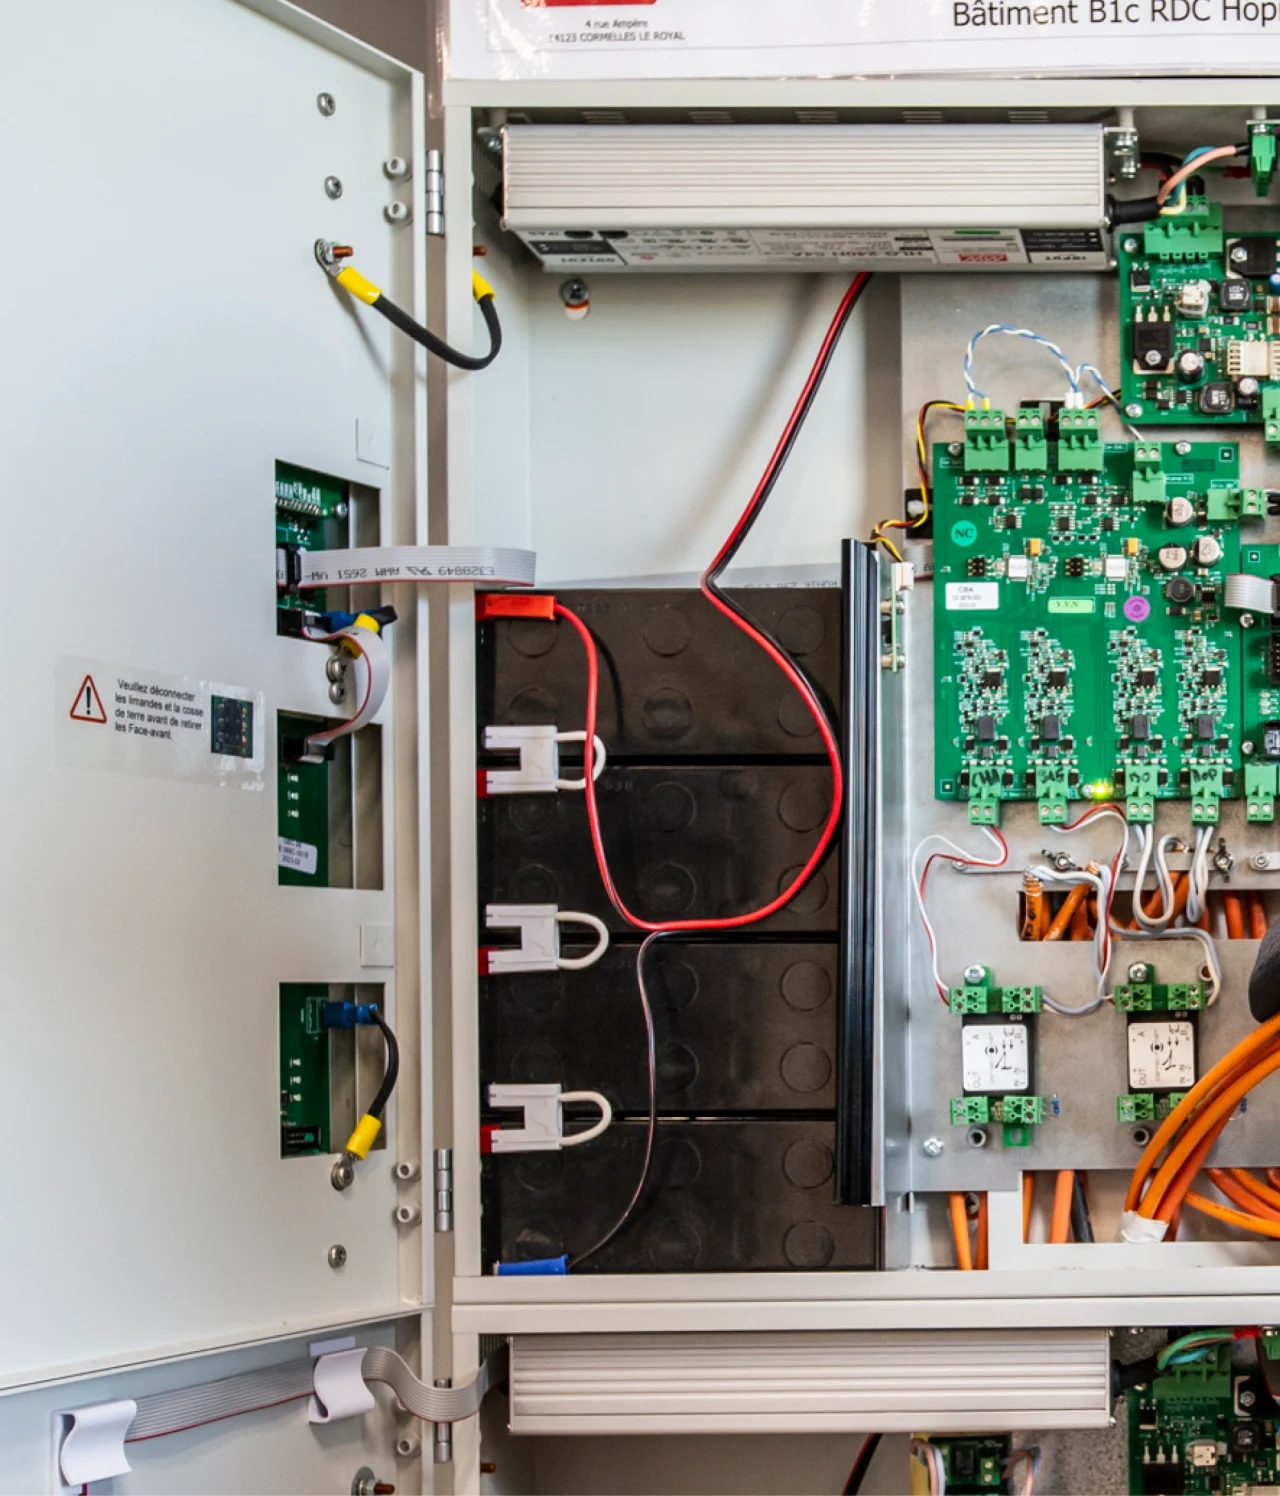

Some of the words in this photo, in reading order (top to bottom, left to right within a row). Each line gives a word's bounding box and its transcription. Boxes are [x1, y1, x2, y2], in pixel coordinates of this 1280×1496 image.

[953, 0, 1078, 26] Bâtiment
[1090, 0, 1139, 24] B1c
[1151, 0, 1210, 22] RDC
[584, 19, 592, 28] 4
[594, 20, 610, 28] rue
[612, 18, 648, 29] Ampère
[579, 31, 637, 42] CORMELLES
[639, 31, 650, 41] LE
[653, 30, 685, 41] ROYAL
[954, 527, 975, 539] NC
[337, 568, 368, 579] 2651
[117, 678, 148, 694] Veuillez
[149, 685, 196, 702] déconnecter
[115, 693, 126, 704] les
[128, 694, 163, 711] limandes
[164, 702, 173, 712] et
[173, 702, 181, 713] la
[182, 706, 204, 718] cosse
[115, 708, 125, 719] de
[126, 709, 146, 721] terre
[147, 712, 168, 725] avant
[170, 716, 179, 727] de
[181, 718, 203, 731] retirer
[115, 721, 126, 733] les
